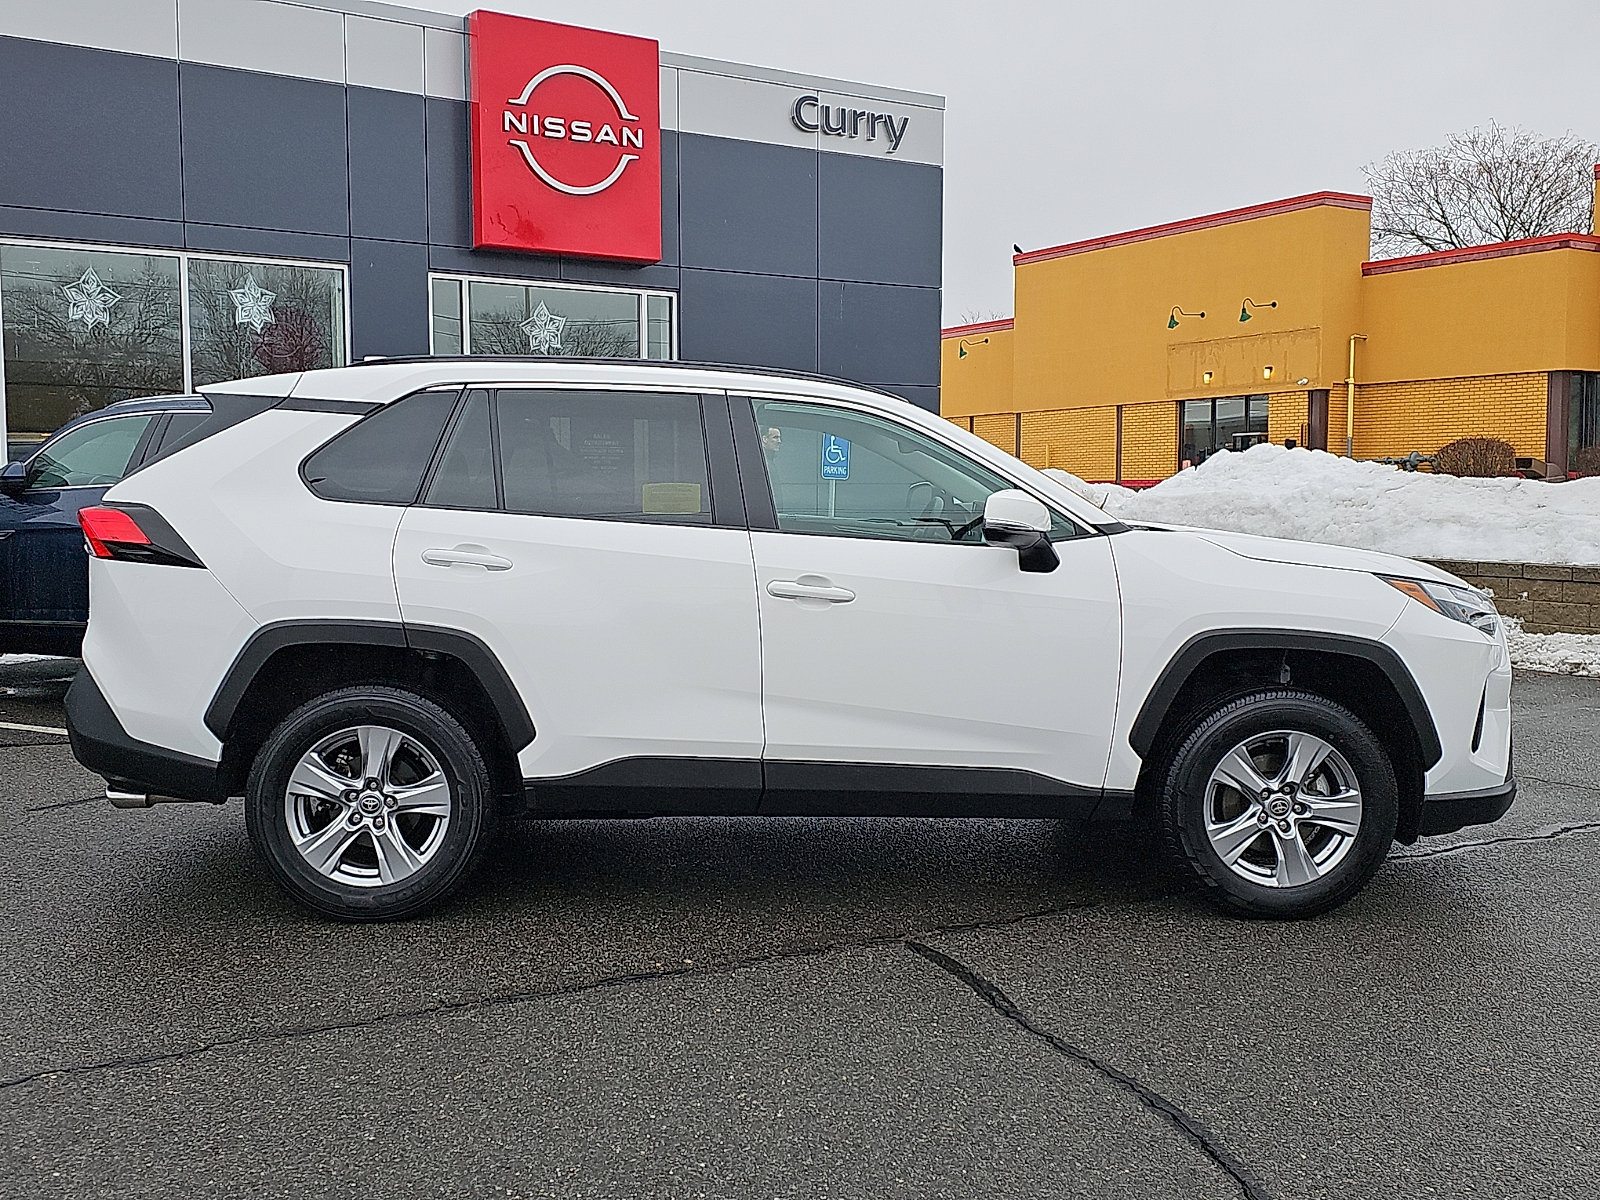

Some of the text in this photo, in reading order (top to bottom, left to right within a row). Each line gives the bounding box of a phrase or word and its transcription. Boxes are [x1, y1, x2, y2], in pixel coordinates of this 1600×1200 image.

[503, 110, 643, 148] NISSAN
[793, 94, 910, 152] Curry
[824, 465, 847, 475] PARKING
